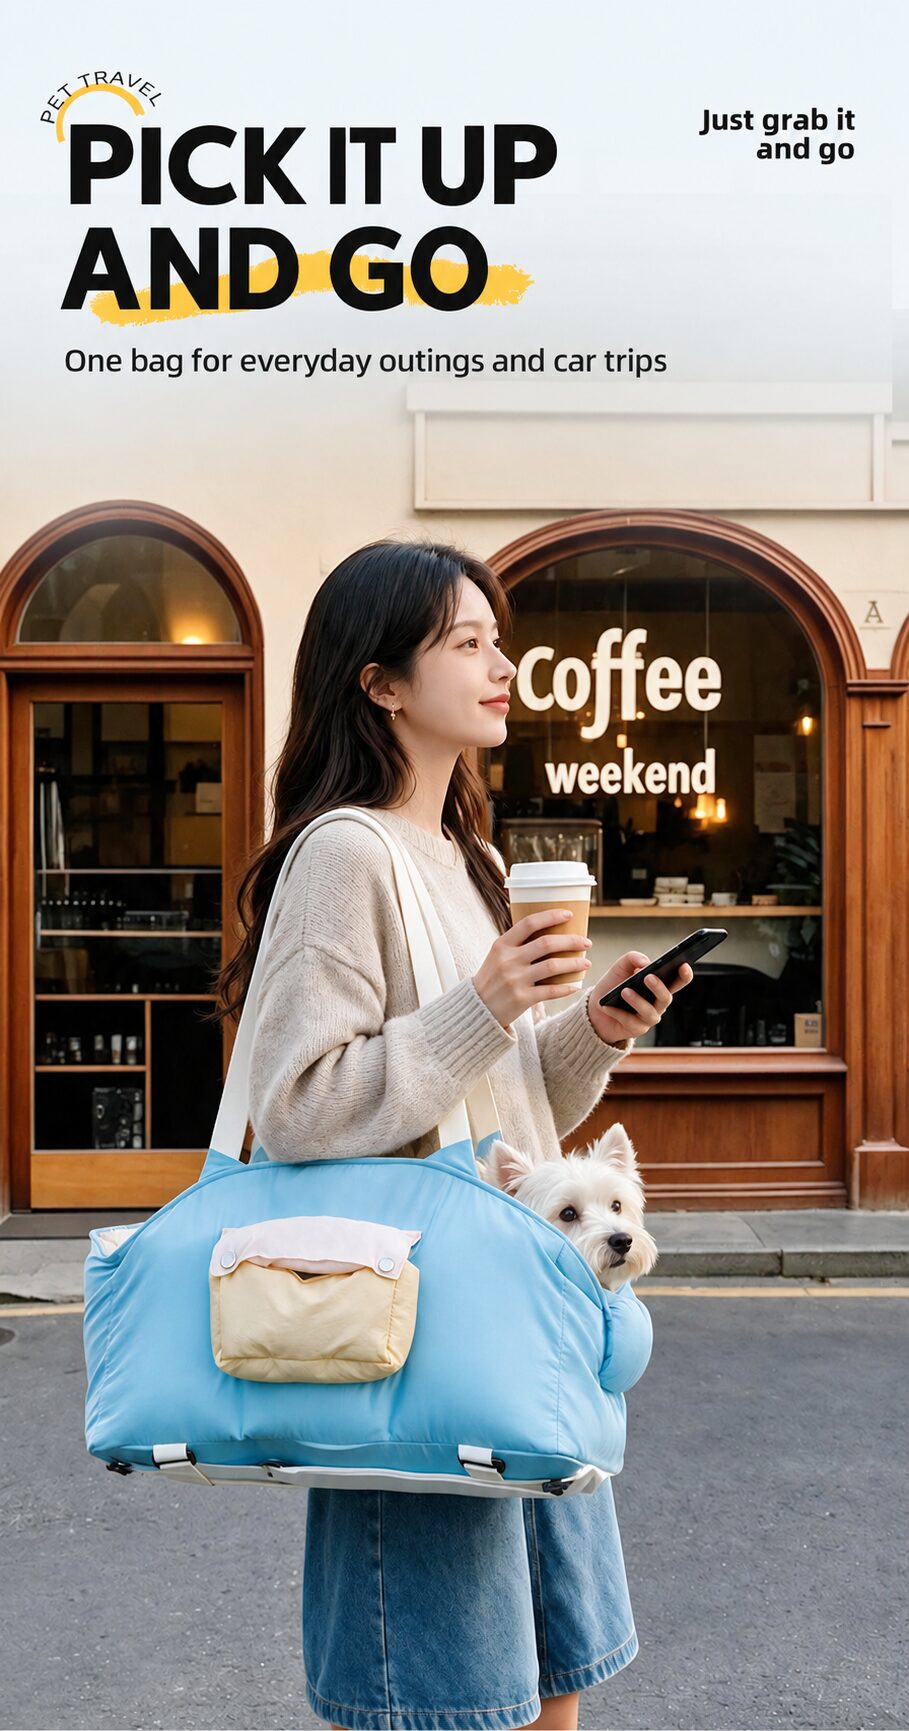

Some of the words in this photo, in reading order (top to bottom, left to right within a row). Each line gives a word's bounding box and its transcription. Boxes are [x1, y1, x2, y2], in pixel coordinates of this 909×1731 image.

[864, 600, 883, 623] A
[516, 627, 722, 740] Coffee
[545, 747, 716, 794] weekend
